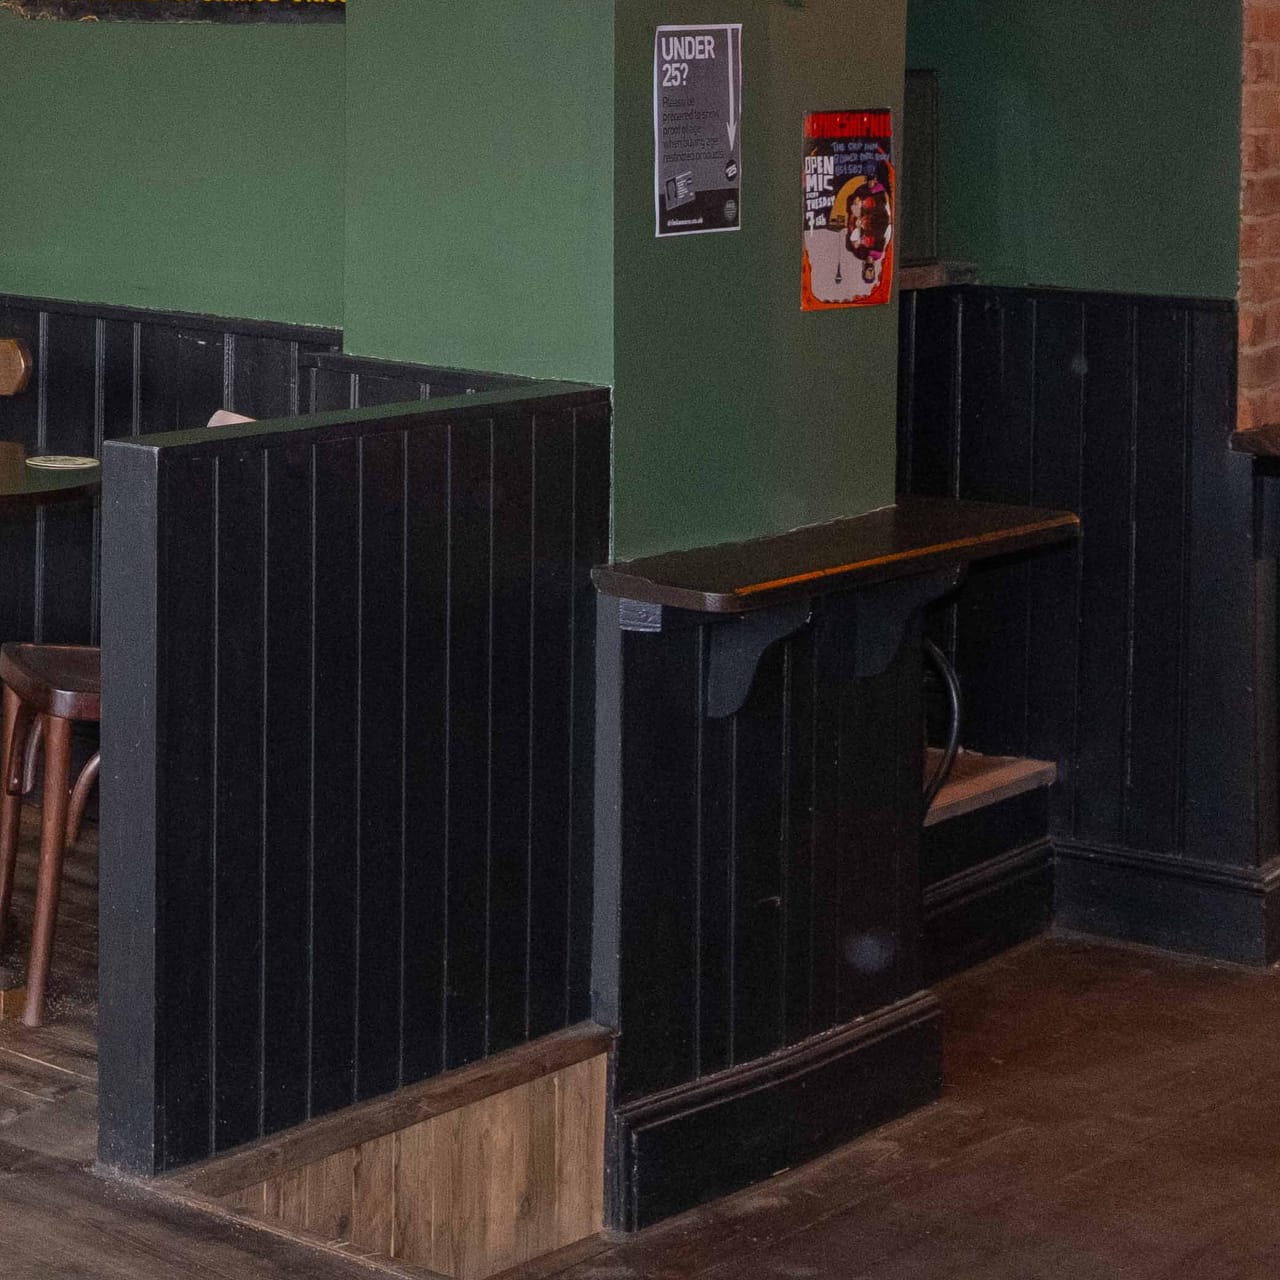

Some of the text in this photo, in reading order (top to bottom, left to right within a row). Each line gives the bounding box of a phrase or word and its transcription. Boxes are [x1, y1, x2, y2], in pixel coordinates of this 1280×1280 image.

[661, 35, 716, 60] UNDER
[662, 62, 689, 87] 25?
[805, 156, 834, 175] OPEN
[806, 174, 834, 192] MIC
[806, 195, 836, 210] TUESDAY
